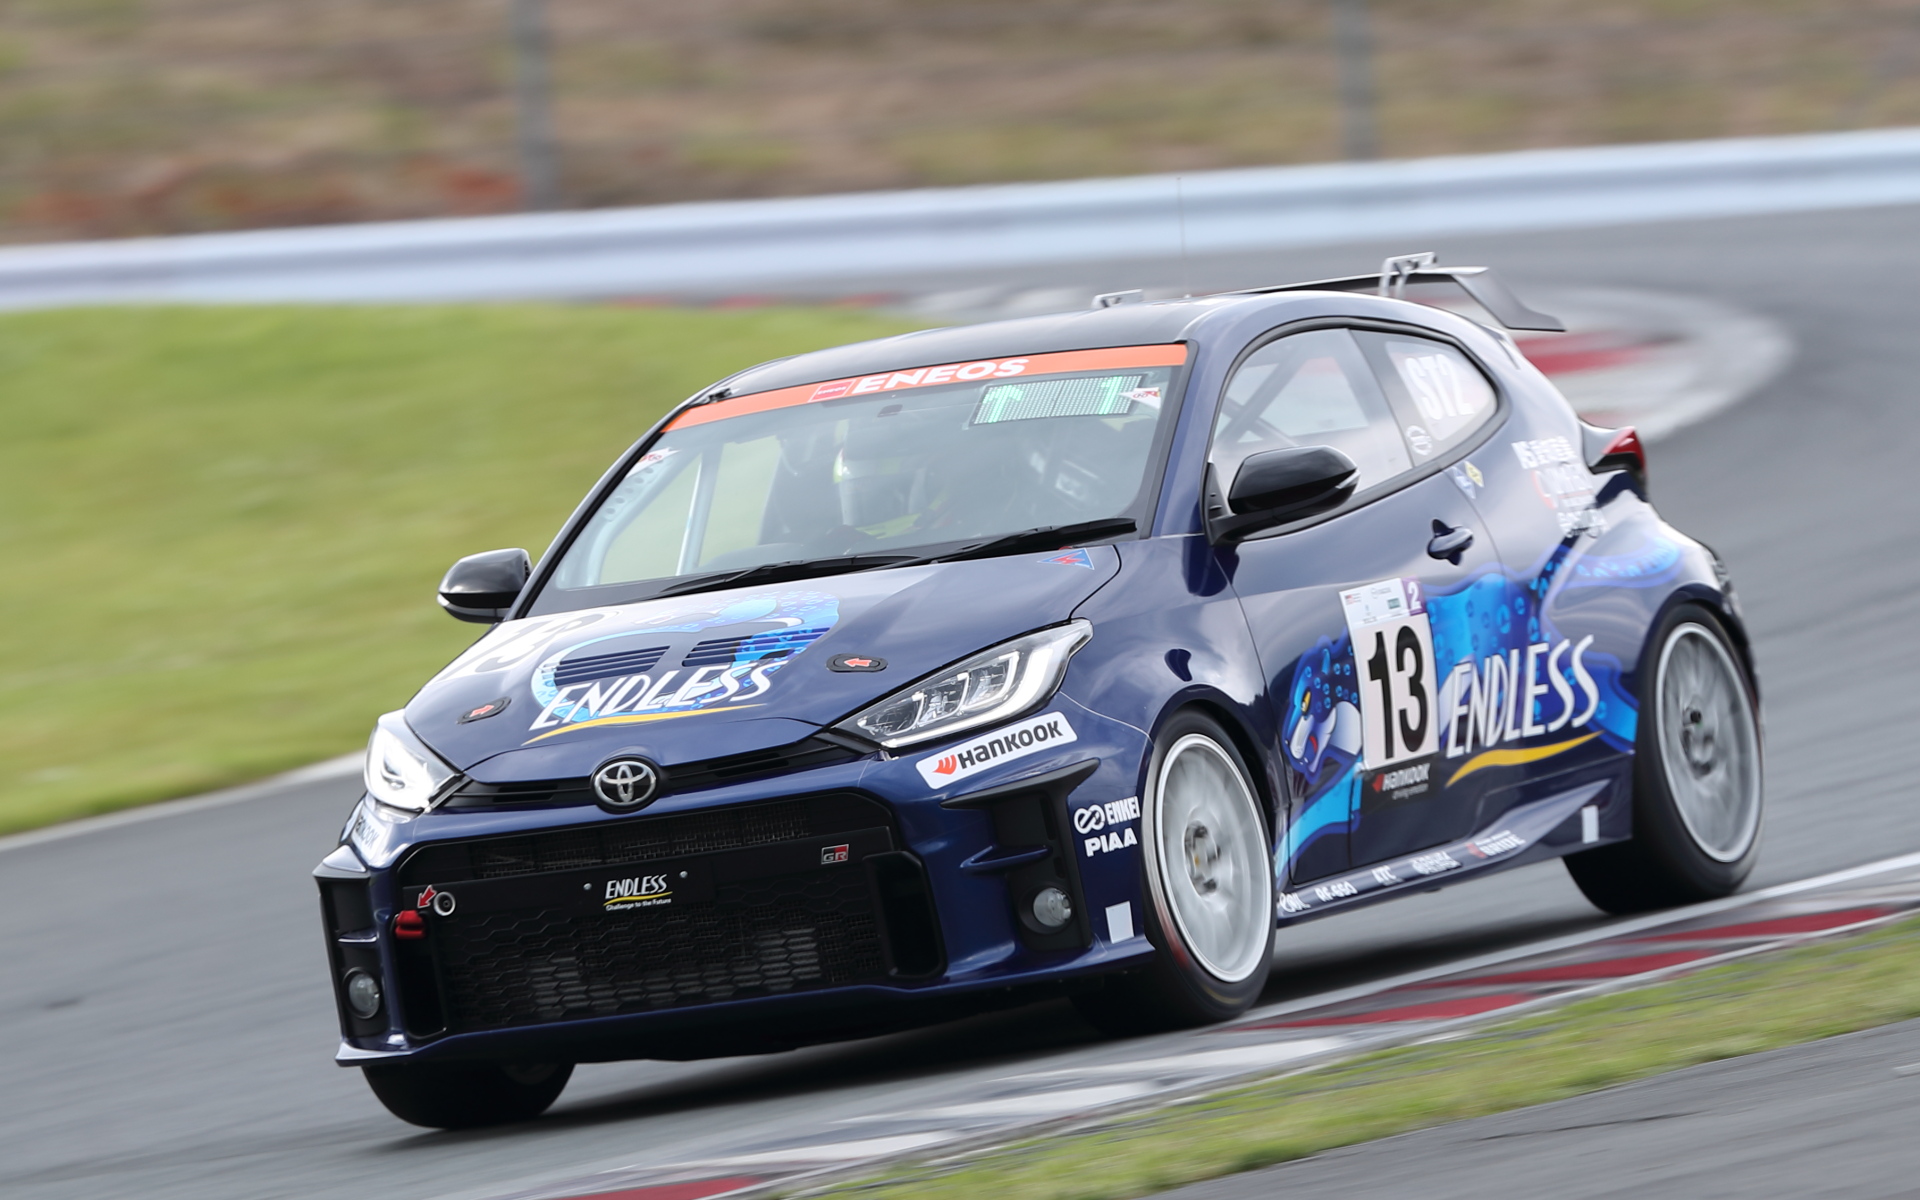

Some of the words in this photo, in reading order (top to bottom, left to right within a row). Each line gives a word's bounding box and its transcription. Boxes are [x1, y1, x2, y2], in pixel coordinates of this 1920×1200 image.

[852, 359, 1029, 394] ENEOS
[1405, 354, 1475, 420] ST2
[1407, 581, 1423, 611] 2
[529, 660, 790, 732] ENDLESS
[1367, 624, 1429, 760] 13
[1446, 634, 1600, 759] ENDLESS
[1104, 795, 1141, 825] ENKEI
[823, 851, 847, 862] GR
[1084, 827, 1138, 858] PIAA
[605, 873, 667, 899] ENDLESS
[605, 902, 634, 911] Challenge
